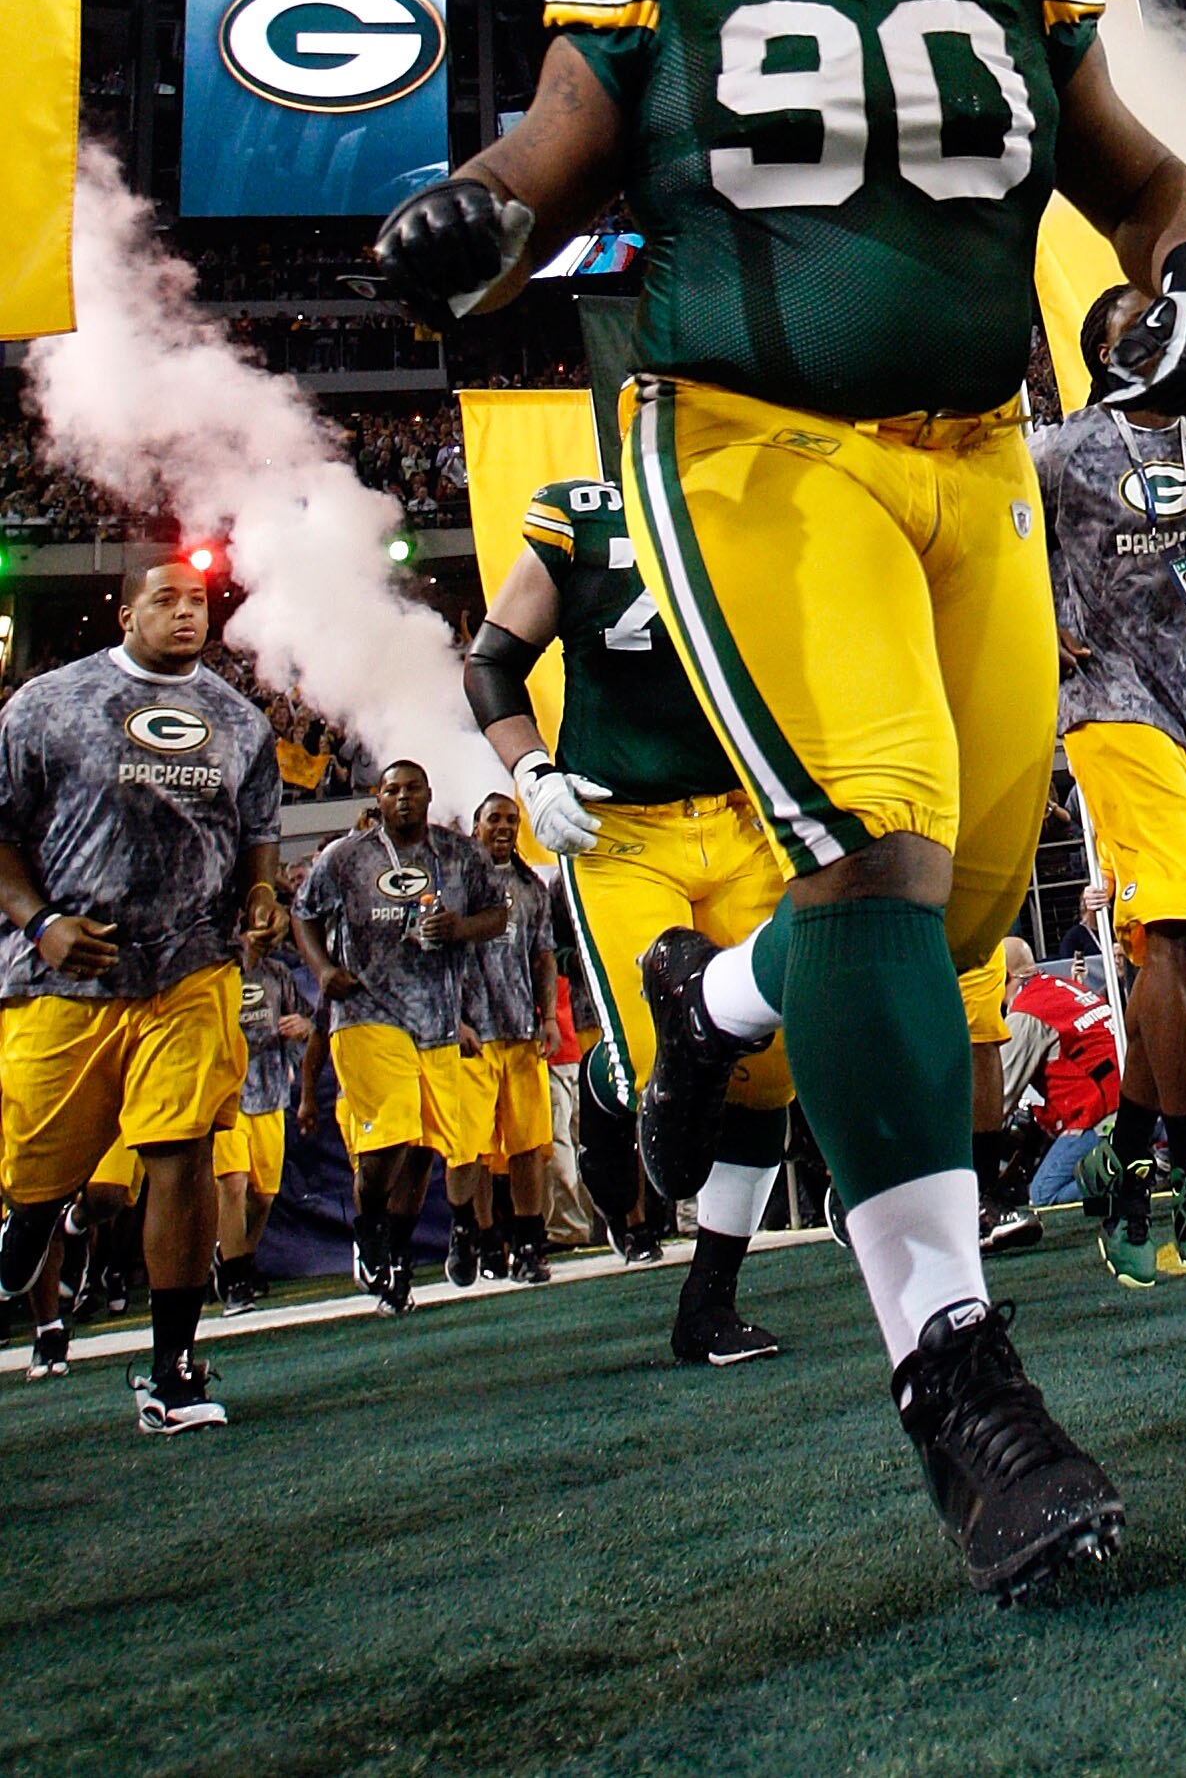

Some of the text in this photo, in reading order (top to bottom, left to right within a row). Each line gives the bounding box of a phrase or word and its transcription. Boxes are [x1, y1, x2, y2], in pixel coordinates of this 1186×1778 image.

[130, 708, 207, 750] G
[118, 763, 222, 788] PACKERS
[377, 866, 429, 897] G
